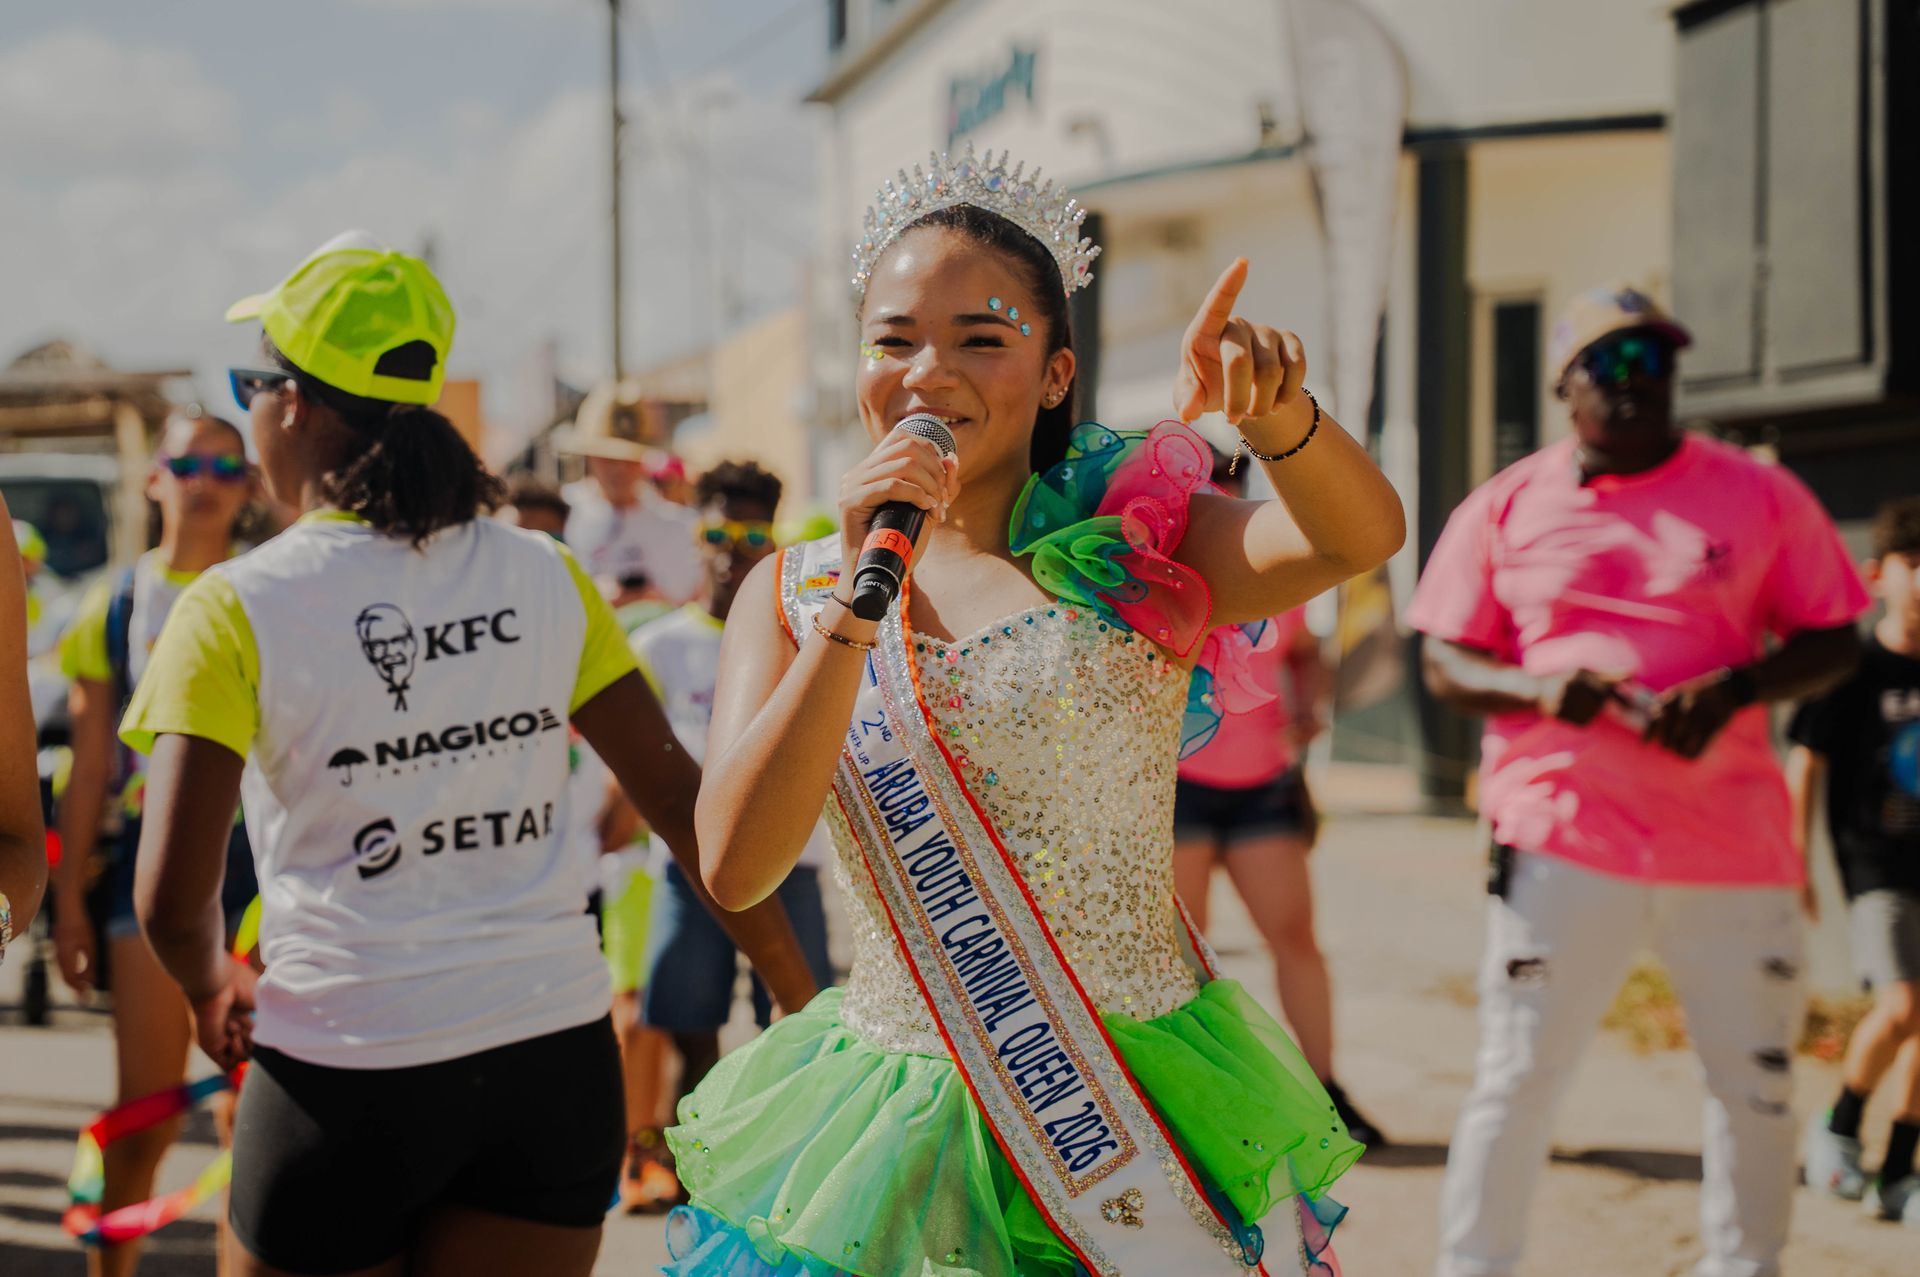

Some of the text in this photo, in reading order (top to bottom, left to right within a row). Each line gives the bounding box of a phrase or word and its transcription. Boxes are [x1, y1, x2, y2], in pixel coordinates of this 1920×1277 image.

[423, 608, 521, 662] KFC
[374, 711, 538, 767] NAGICO
[861, 710, 893, 742] 2ND
[858, 751, 870, 765] UP
[863, 757, 1118, 1173] ARUBA YOUTH CARNIVAL QUEEN 2026
